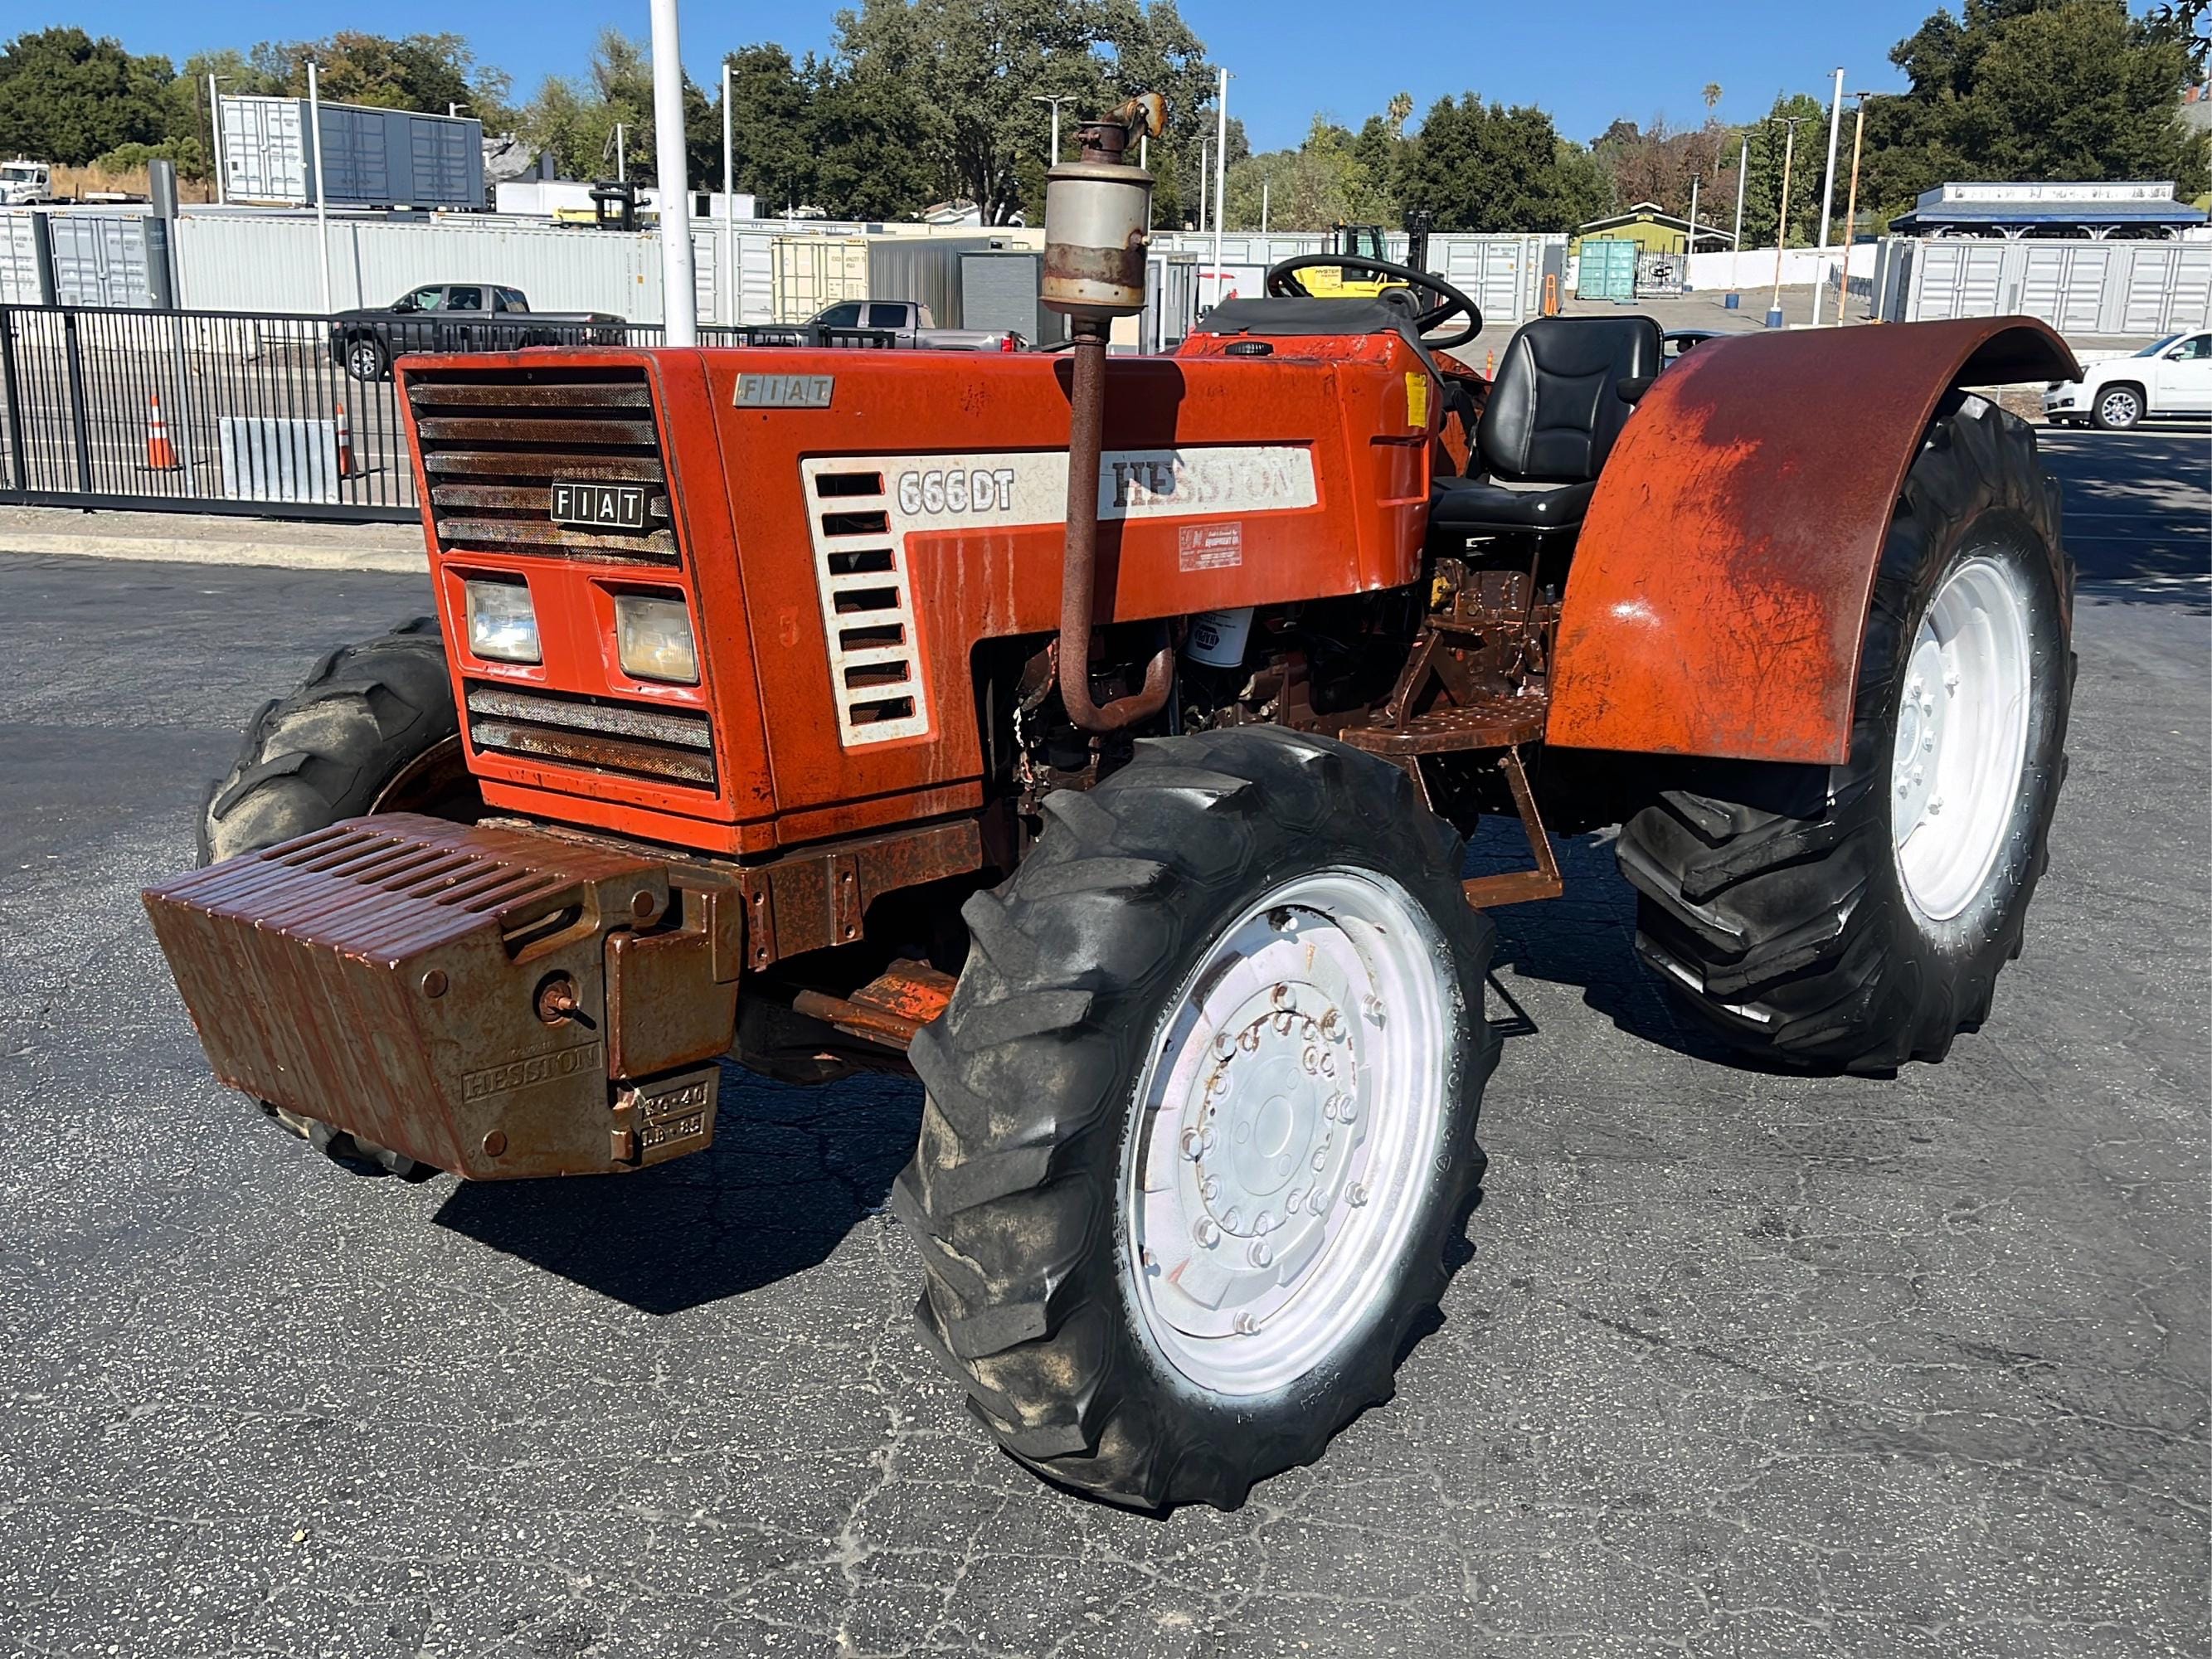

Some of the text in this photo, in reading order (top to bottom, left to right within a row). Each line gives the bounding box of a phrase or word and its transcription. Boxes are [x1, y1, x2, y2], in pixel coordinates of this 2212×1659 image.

[743, 379, 828, 401] FIAT
[1112, 457, 1296, 508] HESSTON
[557, 489, 638, 520] FIAT
[465, 1047, 596, 1099] HESSTON
